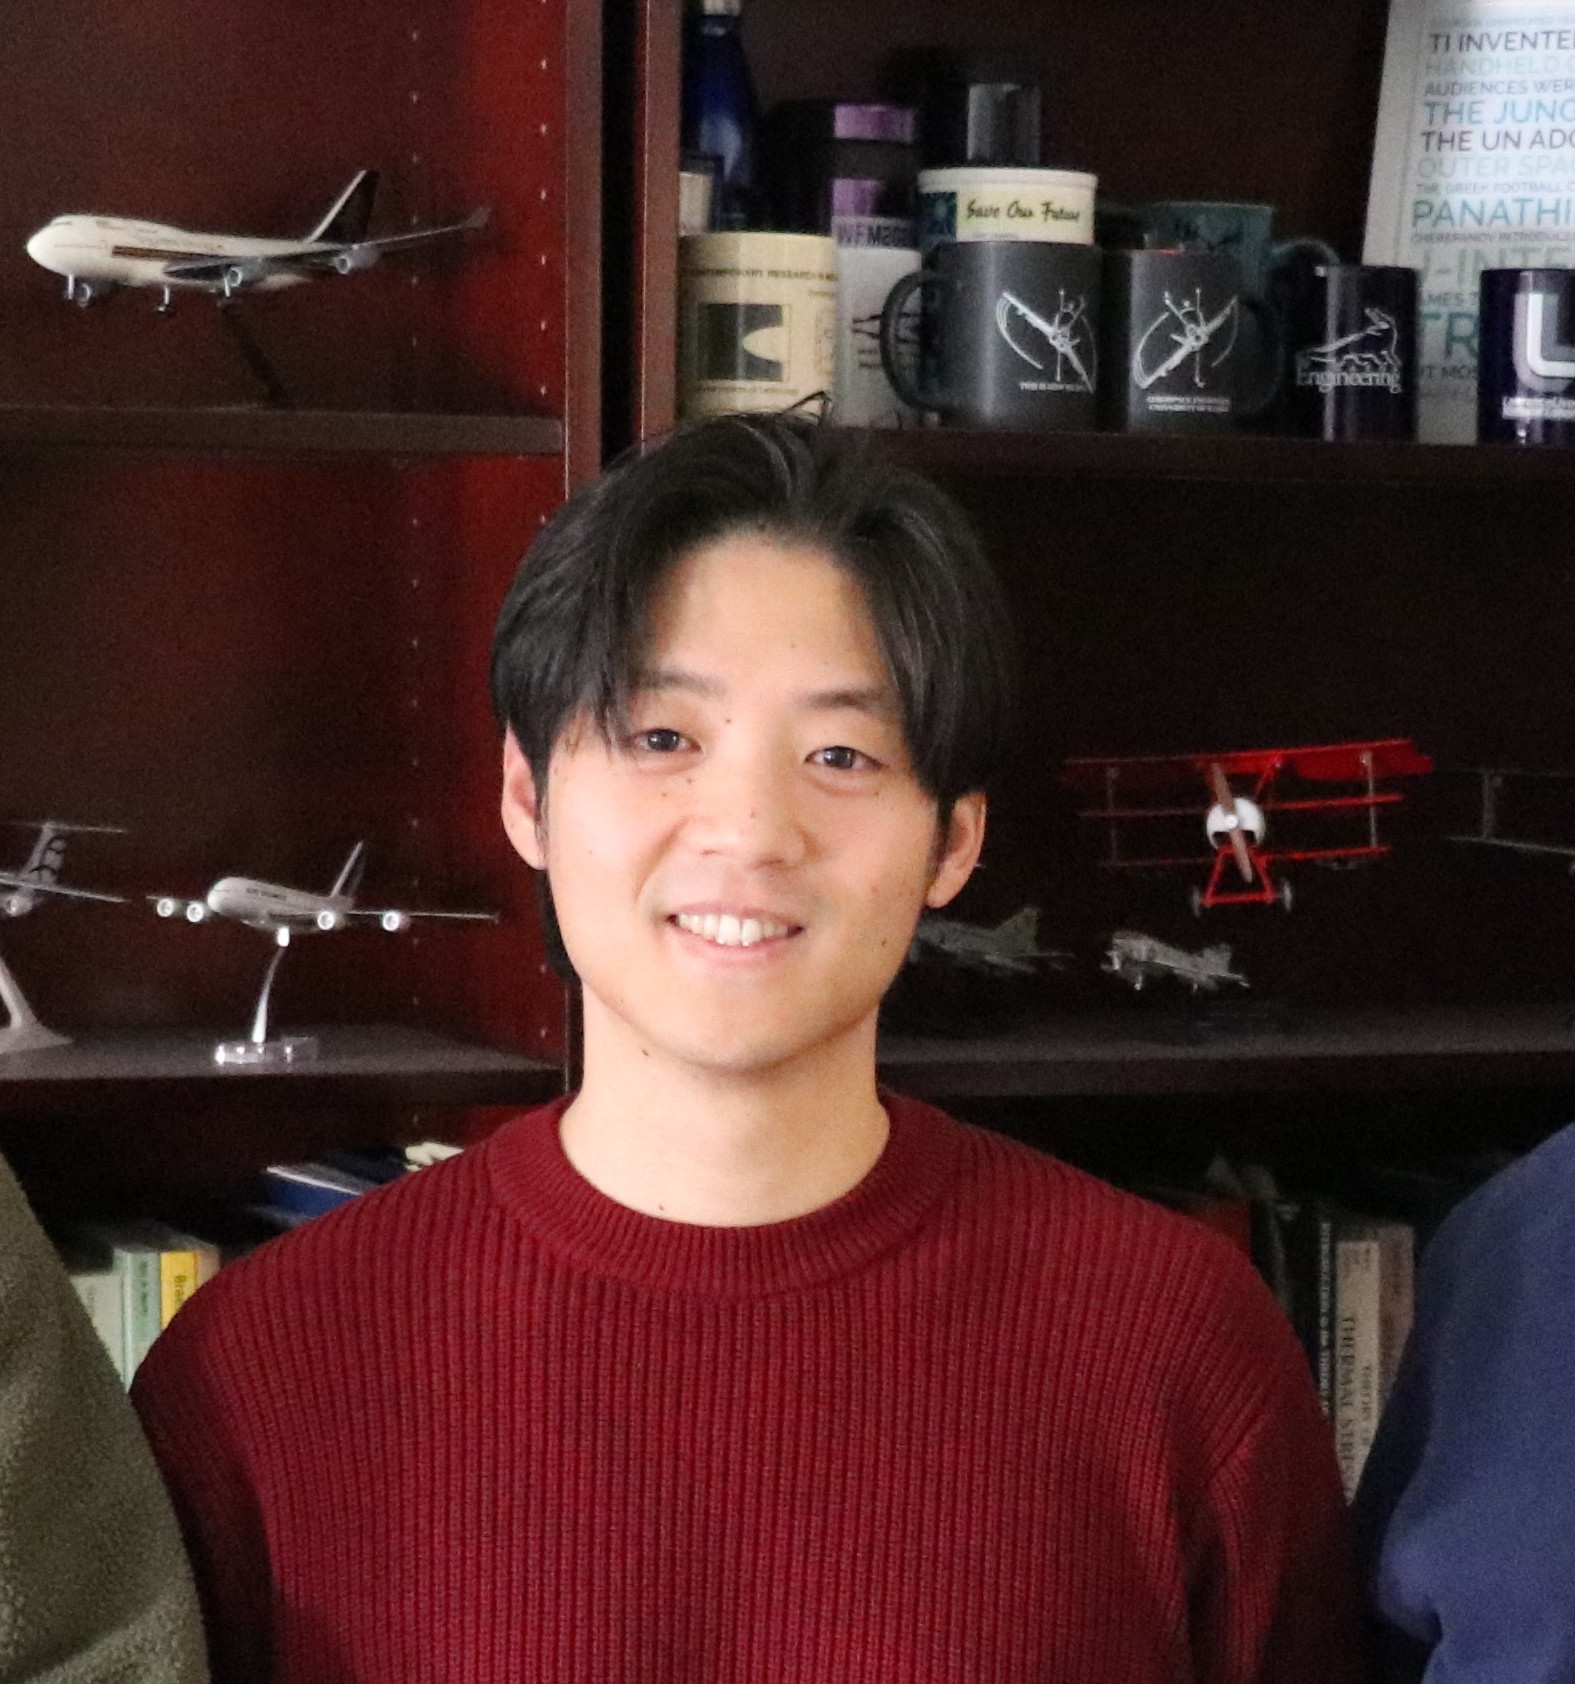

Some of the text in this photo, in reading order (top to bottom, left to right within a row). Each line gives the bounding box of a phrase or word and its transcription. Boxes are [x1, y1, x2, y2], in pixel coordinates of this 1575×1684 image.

[1429, 31, 1451, 52] TI
[1424, 54, 1560, 77] HANDHELD
[1423, 79, 1528, 97] AUDIENCES
[1424, 101, 1485, 126] THE
[1420, 129, 1474, 152] THE
[1481, 128, 1522, 151] UN
[1416, 155, 1509, 179] OUTER
[1493, 180, 1562, 194] FOOTBALL
[966, 198, 1001, 221] Save
[1295, 359, 1402, 394] Engineering
[1338, 1316, 1356, 1409] THERMAL
